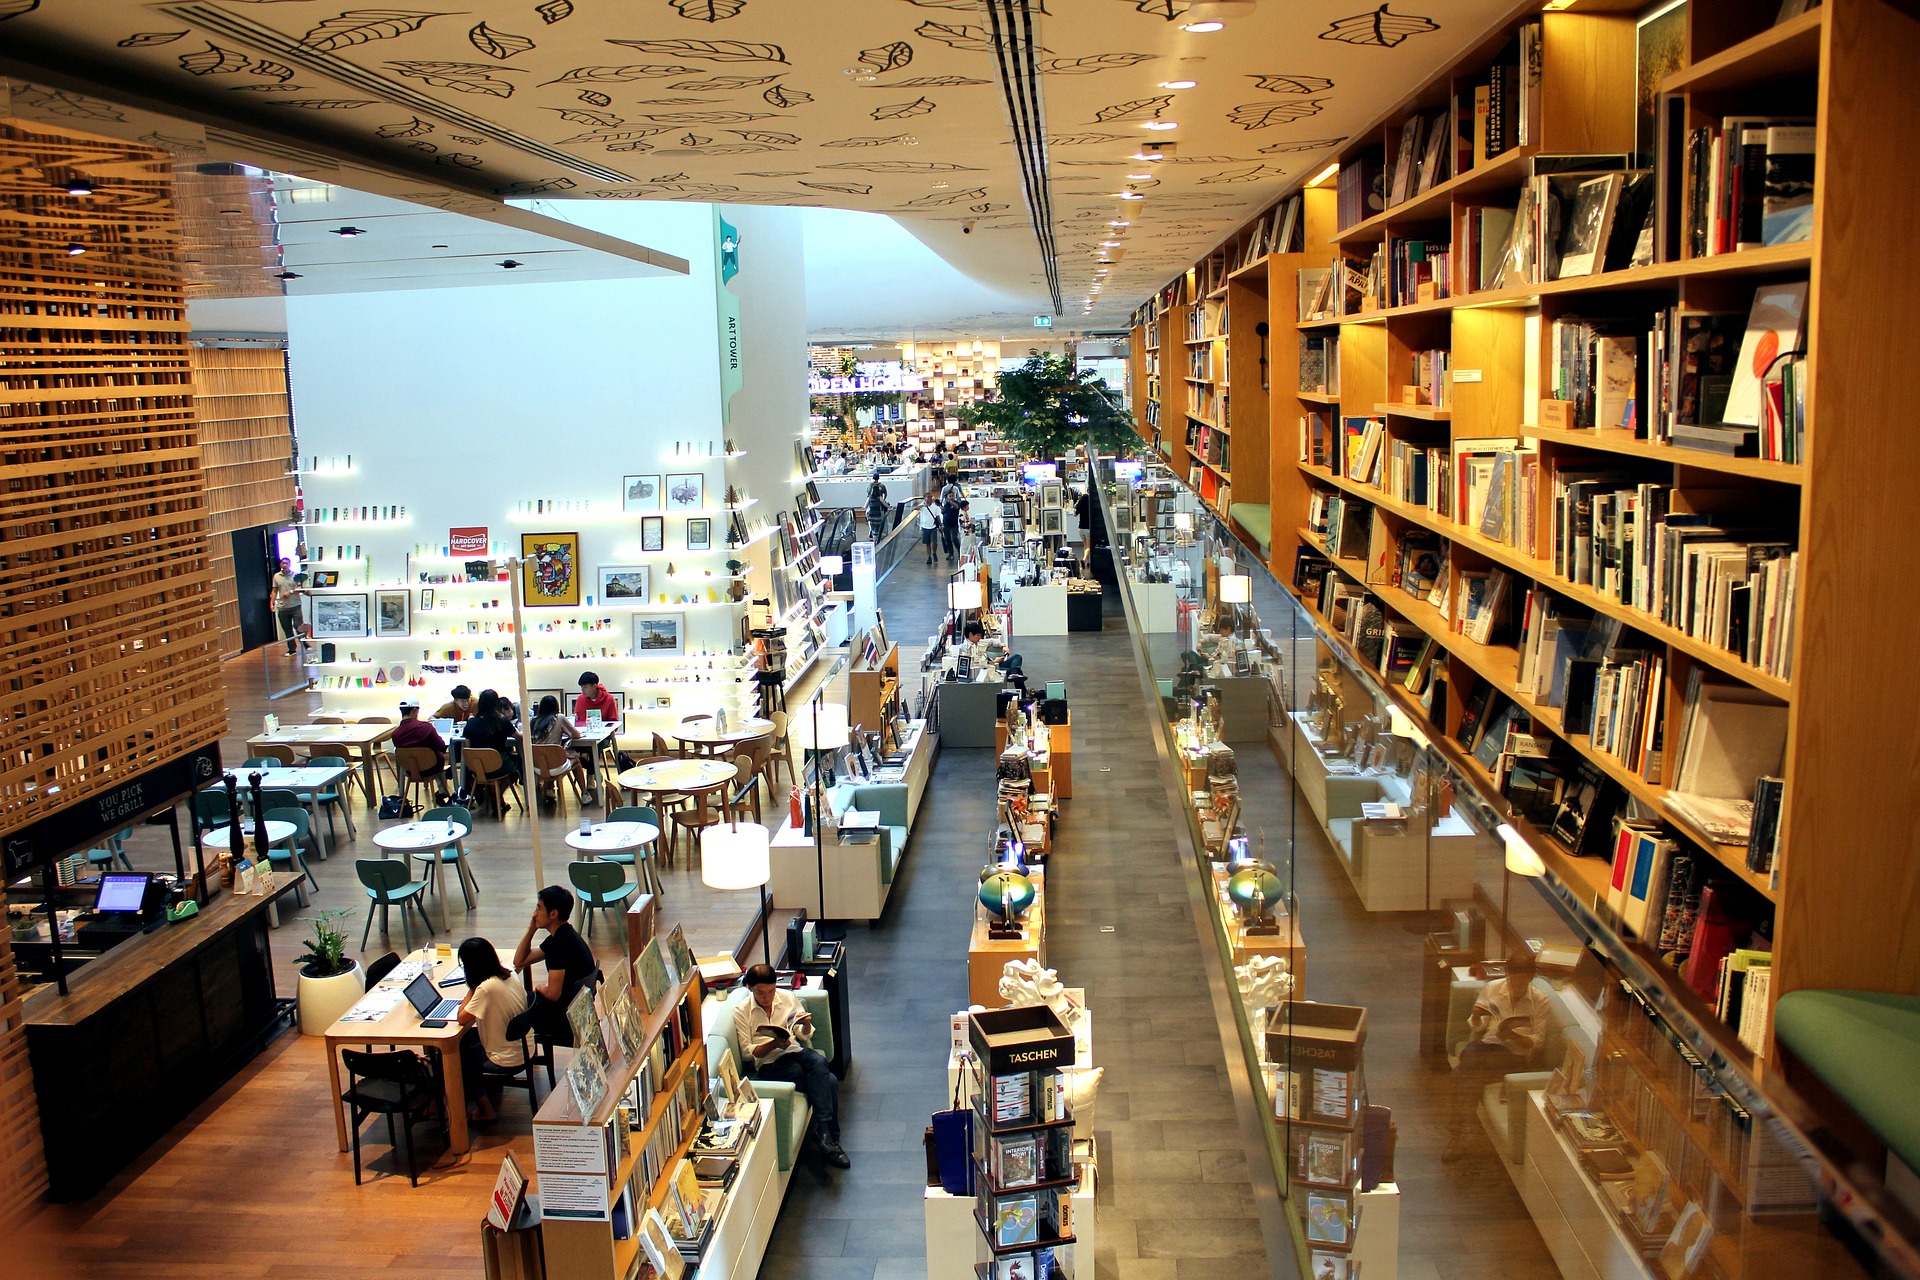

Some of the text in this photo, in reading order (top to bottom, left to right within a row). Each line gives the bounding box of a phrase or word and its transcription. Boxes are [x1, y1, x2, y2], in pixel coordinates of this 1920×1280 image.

[728, 316, 738, 370] ART TOWER
[451, 537, 487, 545] HARDCOVER
[99, 783, 143, 810] YOU PICK
[101, 796, 144, 822] WE GRILL
[1009, 1048, 1058, 1064] TASCHEN
